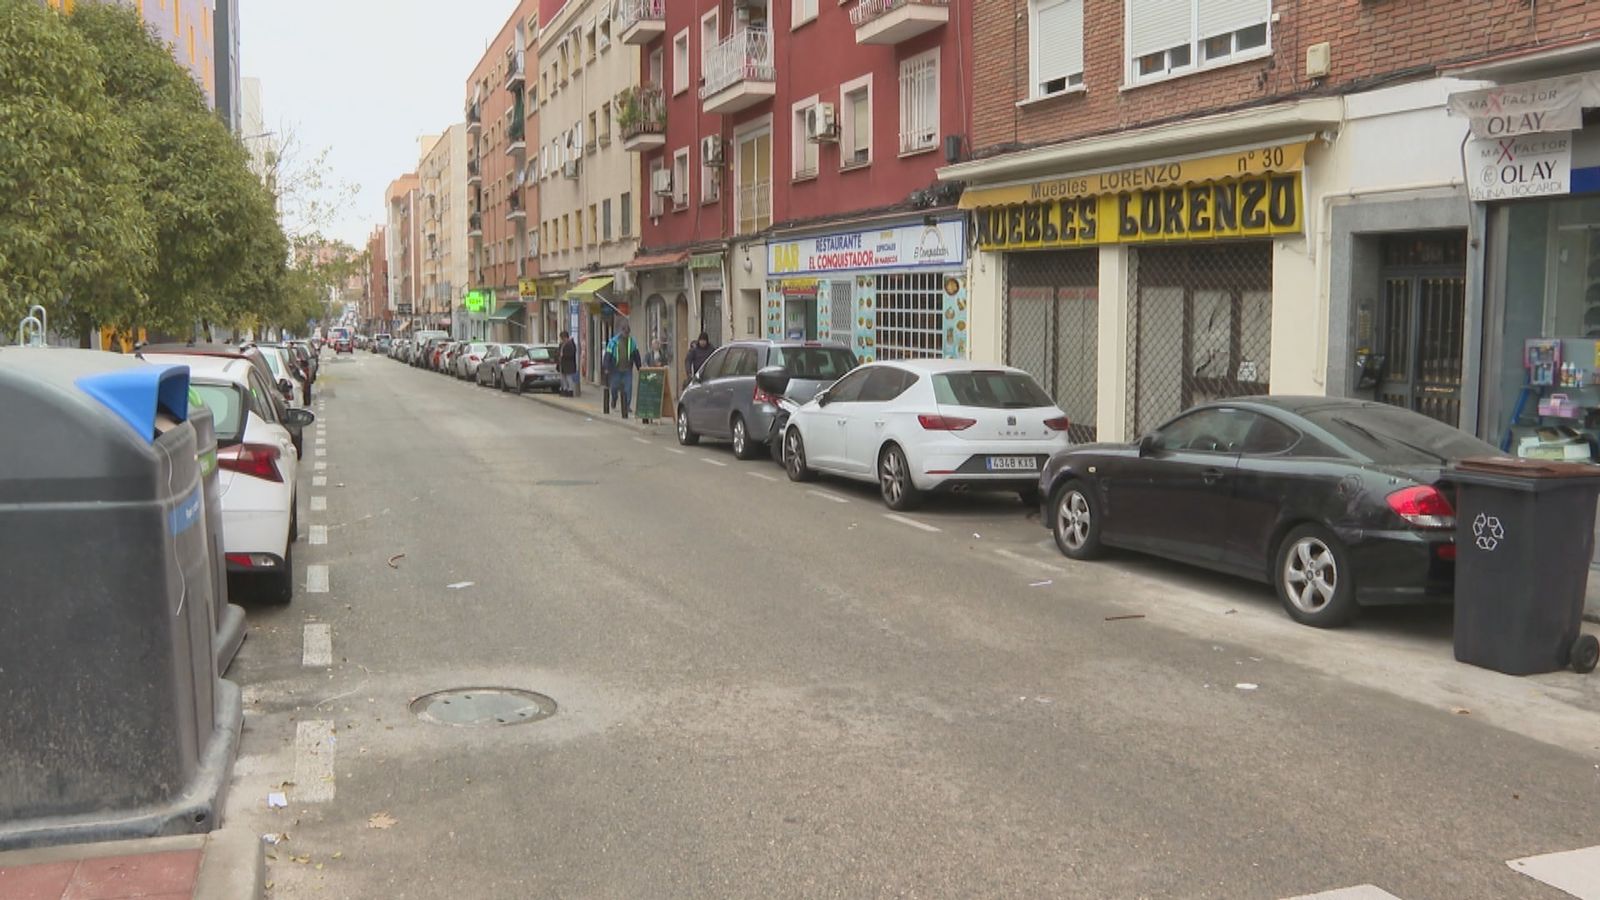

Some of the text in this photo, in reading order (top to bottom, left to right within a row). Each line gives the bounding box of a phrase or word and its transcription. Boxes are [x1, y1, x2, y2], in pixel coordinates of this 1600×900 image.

[1487, 111, 1545, 135] OLAY
[1514, 140, 1567, 155] FACTOR
[1031, 179, 1087, 200] Muebles
[1100, 163, 1181, 190] LORENZO
[1262, 147, 1284, 168] 30
[1501, 160, 1557, 185] OLAY
[1118, 175, 1296, 237] LORENZO
[816, 234, 862, 253] RESTAURANTE
[774, 243, 799, 273] BAR
[809, 250, 874, 270] EL CONQUISTADOR
[993, 458, 1016, 468] 4348
